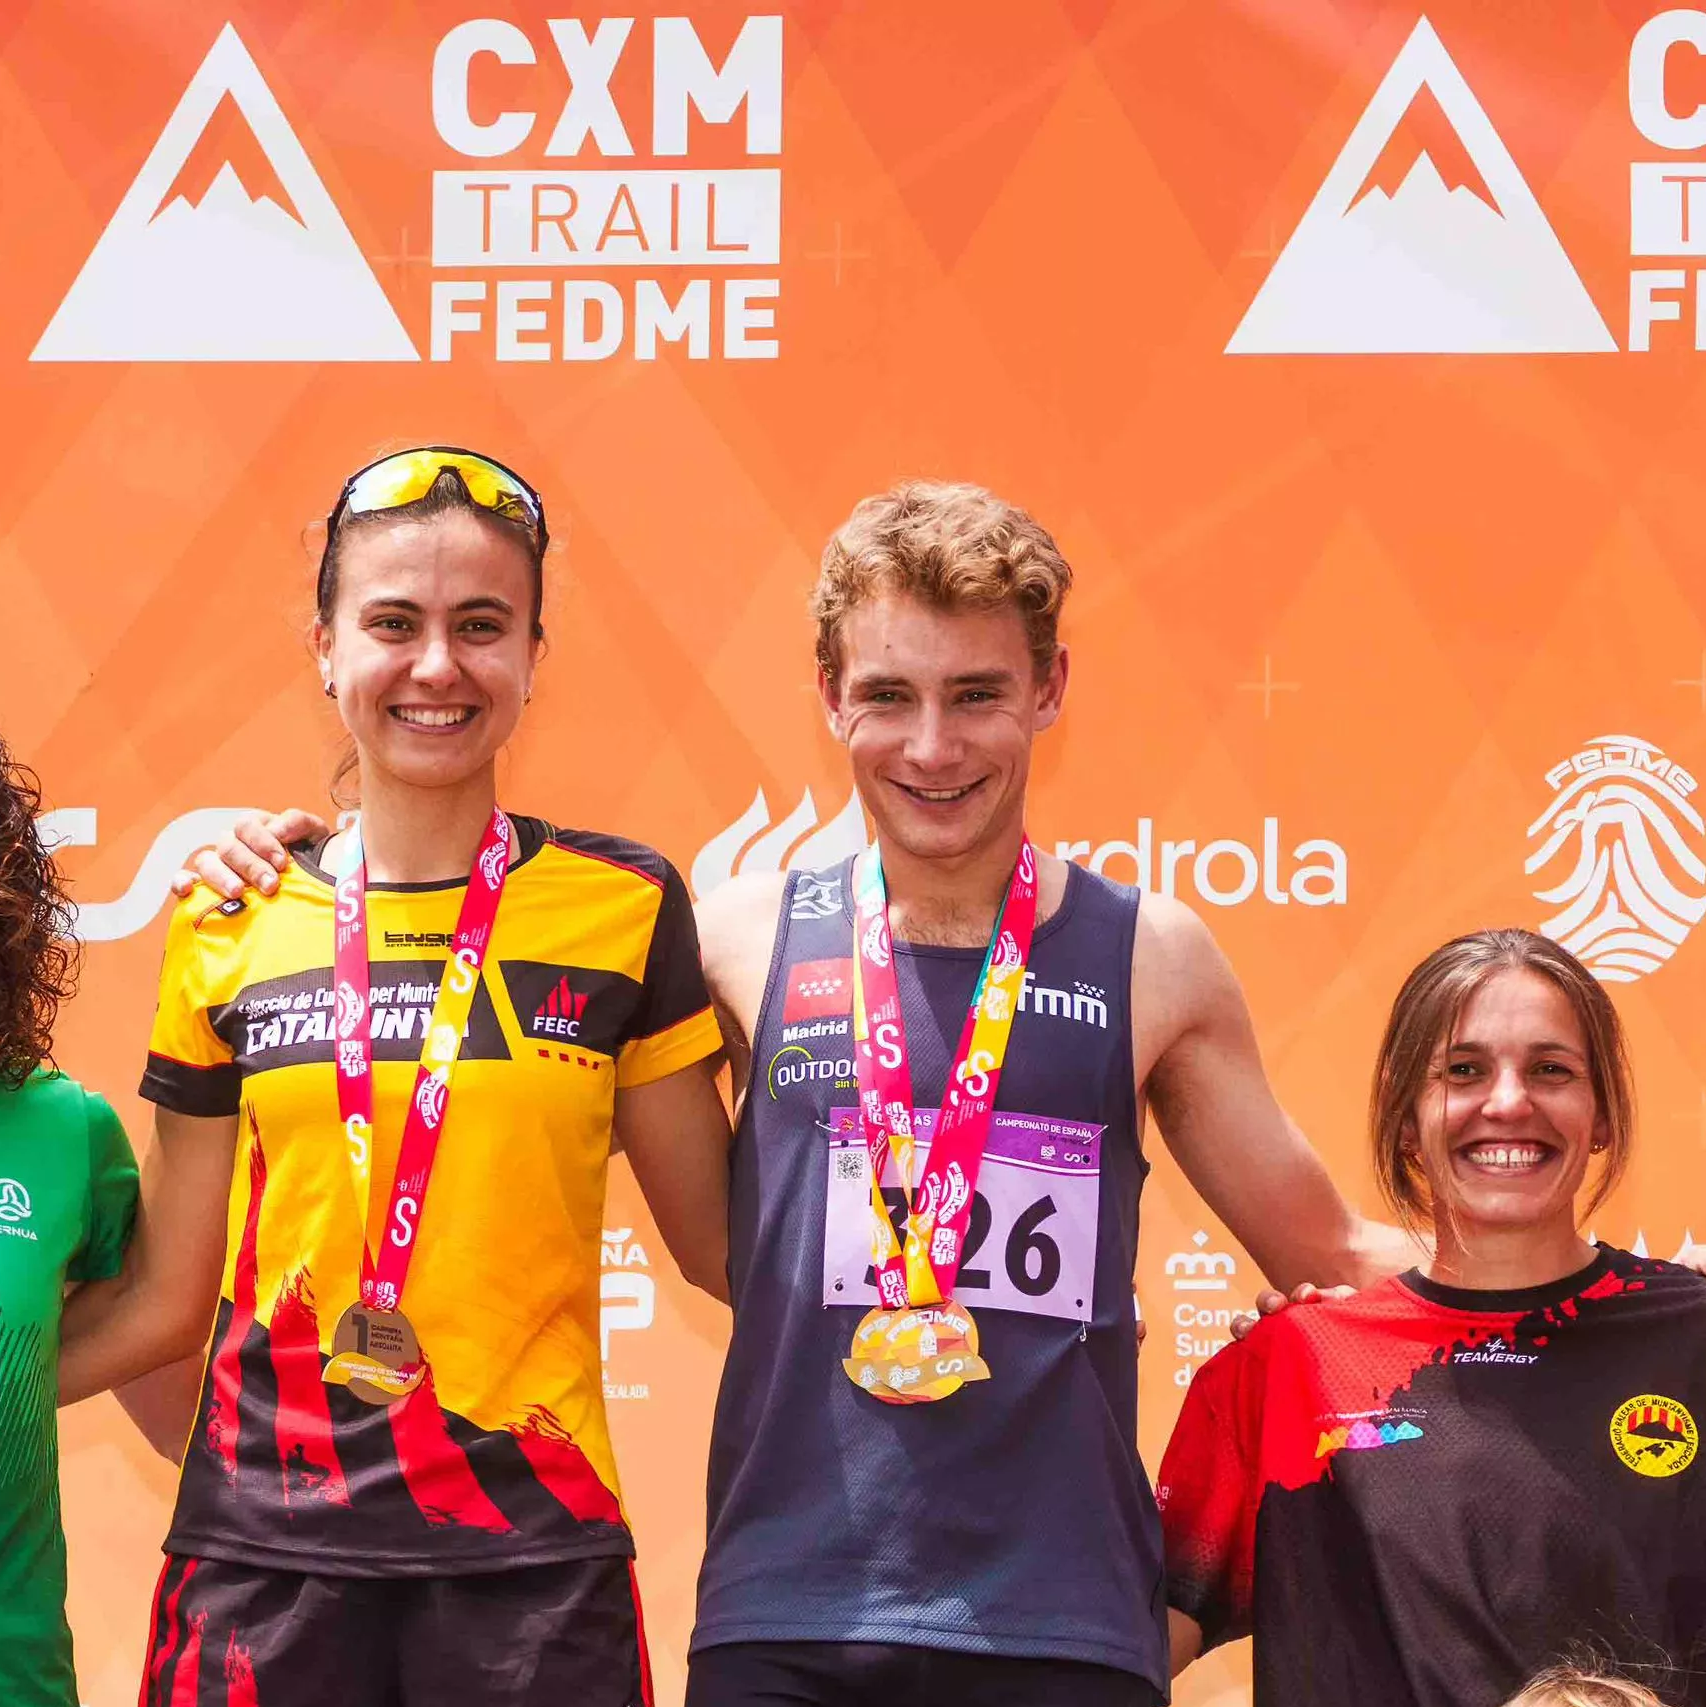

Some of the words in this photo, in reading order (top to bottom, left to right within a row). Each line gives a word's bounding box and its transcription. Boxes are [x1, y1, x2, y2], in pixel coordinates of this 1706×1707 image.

[430, 14, 784, 157] CXM
[463, 183, 751, 253] TRAIL
[430, 279, 781, 362] FEDME
[368, 985, 396, 1008] per
[532, 1015, 580, 1037] FEEC
[782, 1020, 848, 1043] Madrid
[995, 1117, 1049, 1133] CAMPEONATO
[1050, 1124, 1061, 1134] DE
[1061, 1123, 1093, 1139] ESPAÑA
[1453, 1351, 1539, 1366] TEAMERGY
[1635, 1398, 1647, 1407] DE
